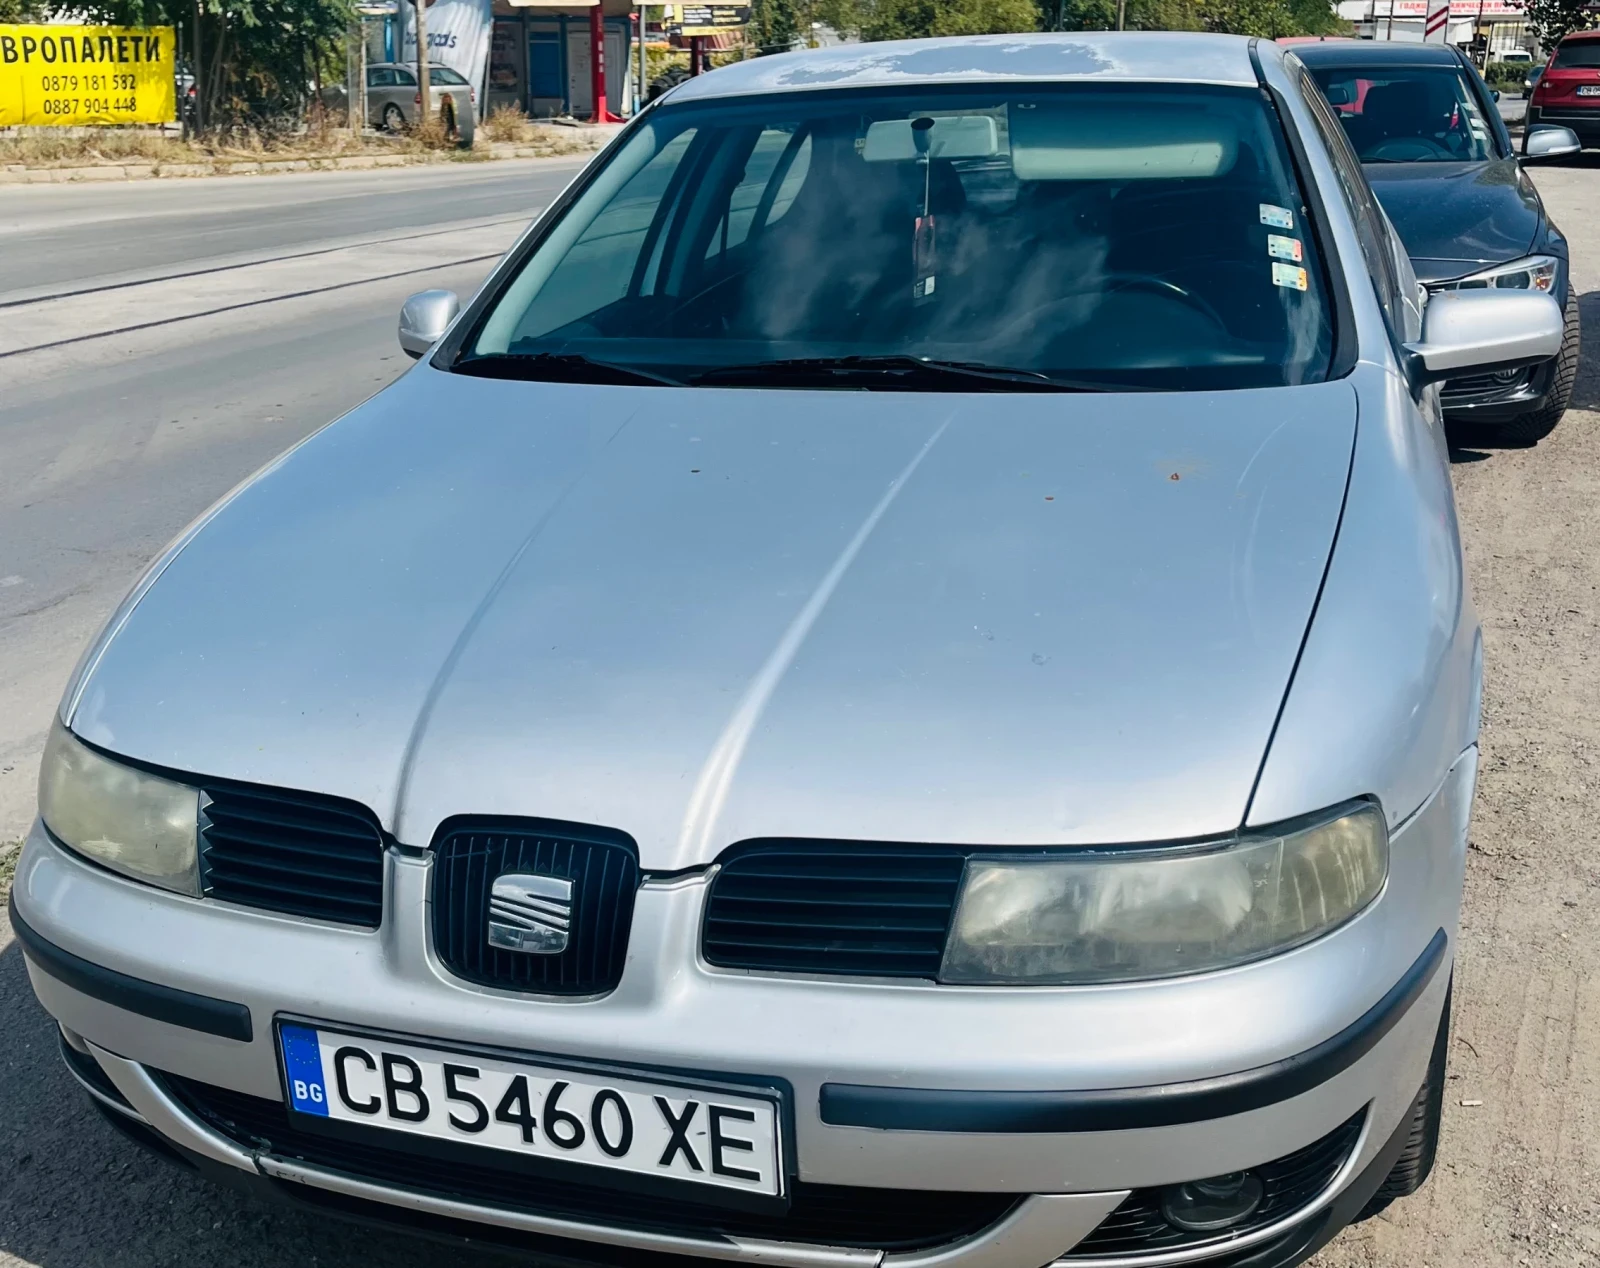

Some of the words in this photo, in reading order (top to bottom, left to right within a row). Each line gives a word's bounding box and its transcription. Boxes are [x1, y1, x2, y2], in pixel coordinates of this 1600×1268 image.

[0, 36, 161, 64] ВРОПАЛЕТИ
[42, 75, 78, 91] 0879
[83, 75, 107, 91] 181
[43, 99, 79, 115] 0887
[84, 98, 109, 114] 904
[113, 96, 137, 112] 448
[294, 1079, 323, 1103] BG
[652, 1095, 761, 1182] XE
